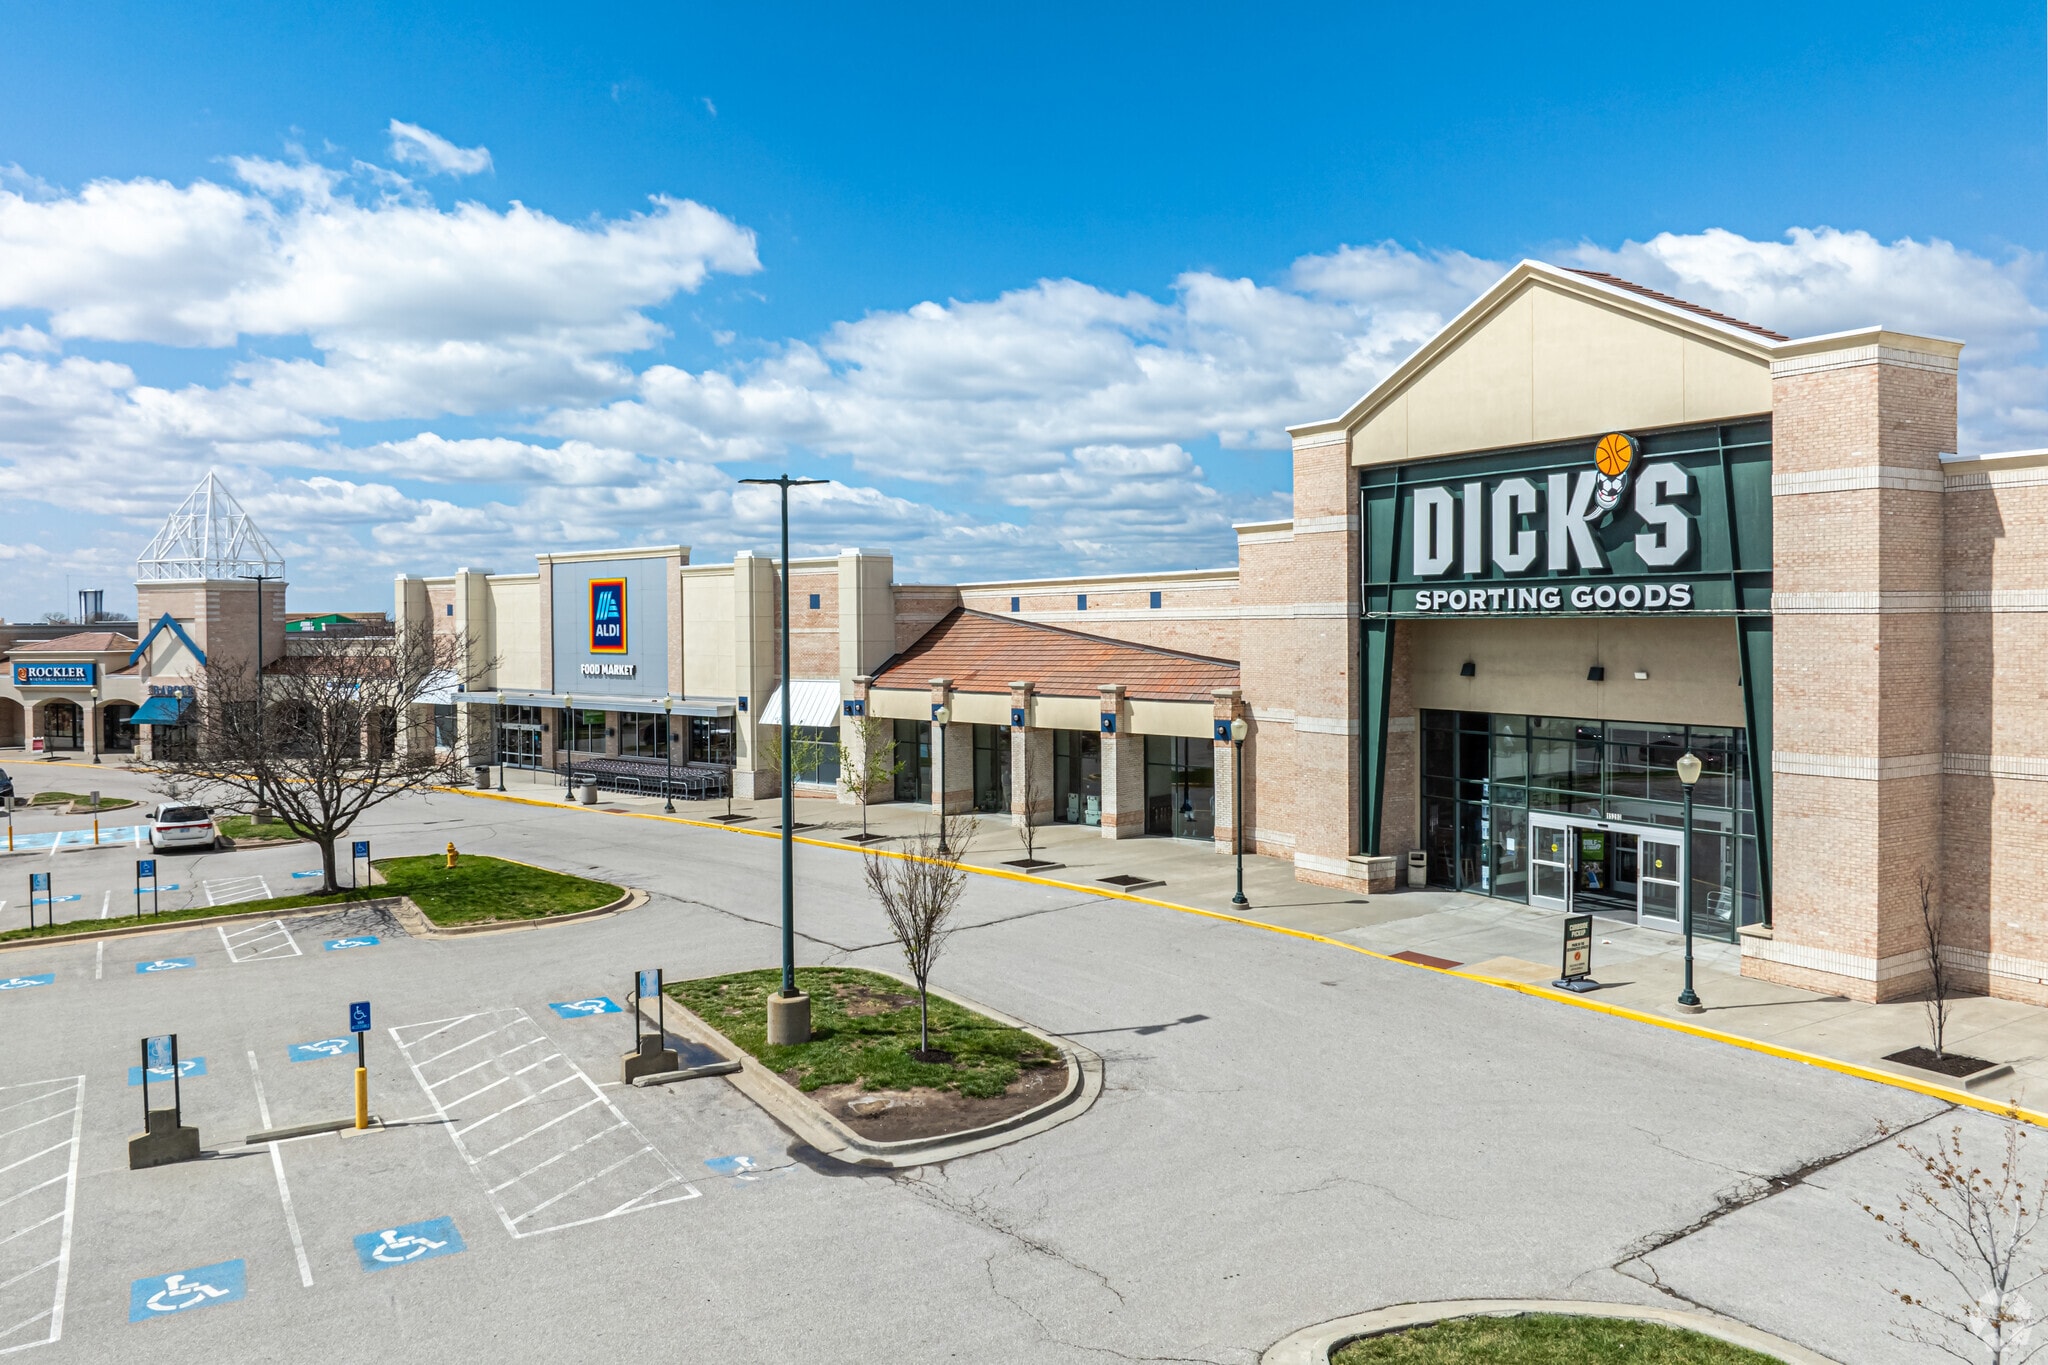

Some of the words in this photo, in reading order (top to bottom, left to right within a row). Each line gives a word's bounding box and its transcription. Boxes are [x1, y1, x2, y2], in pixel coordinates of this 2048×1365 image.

[1413, 462, 1689, 576] DICK'S
[1415, 587, 1560, 610] SPORTING
[1571, 584, 1691, 608] GOODS
[595, 624, 620, 637] ALDI
[28, 667, 85, 677] ROCKLER
[581, 664, 601, 675] FOOD
[601, 664, 633, 676] MARKET
